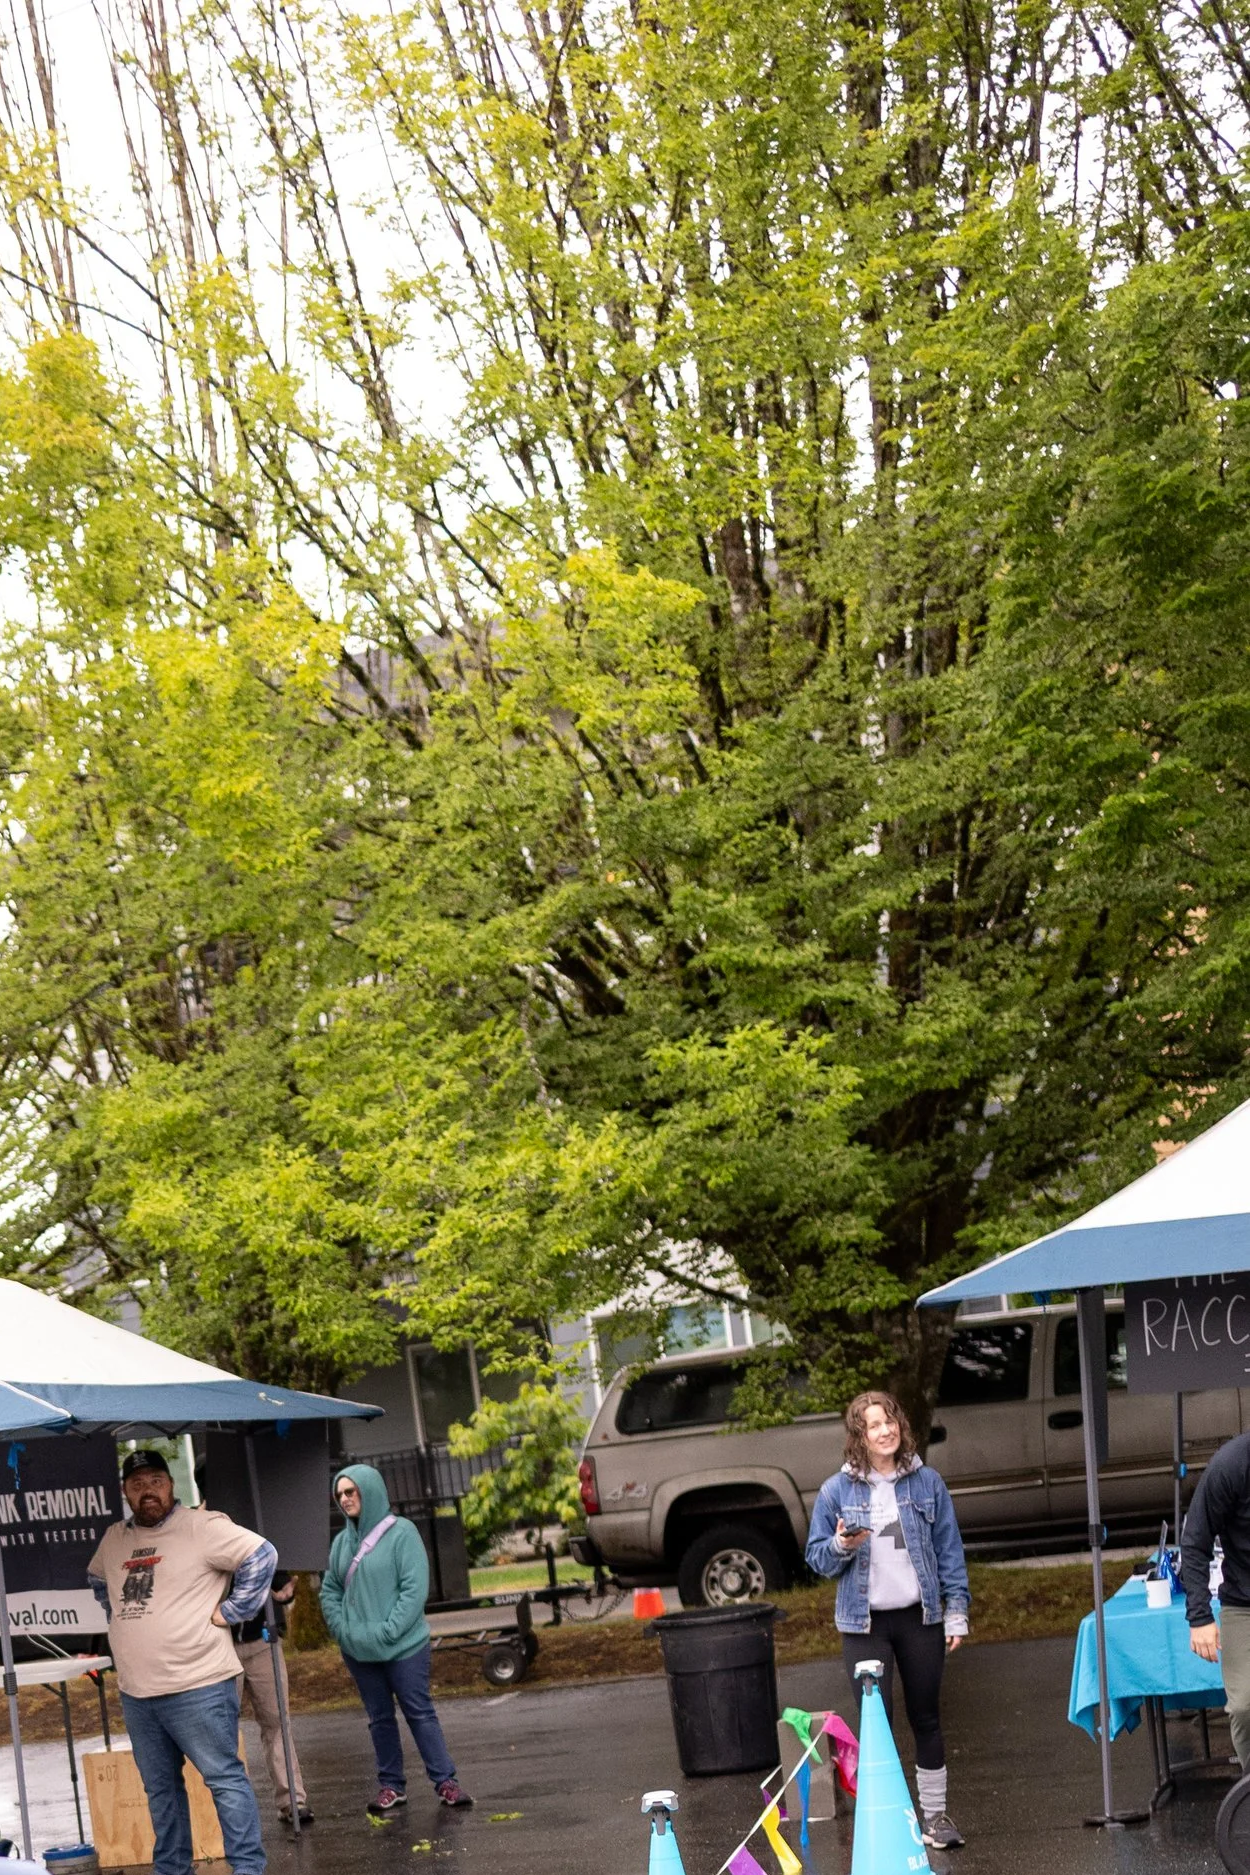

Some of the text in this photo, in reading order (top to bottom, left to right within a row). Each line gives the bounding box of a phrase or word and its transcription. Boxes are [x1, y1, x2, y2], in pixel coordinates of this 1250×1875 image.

[24, 1485, 113, 1521] REMOVAL
[0, 1533, 35, 1547] WITH
[44, 1528, 96, 1542] YETTER
